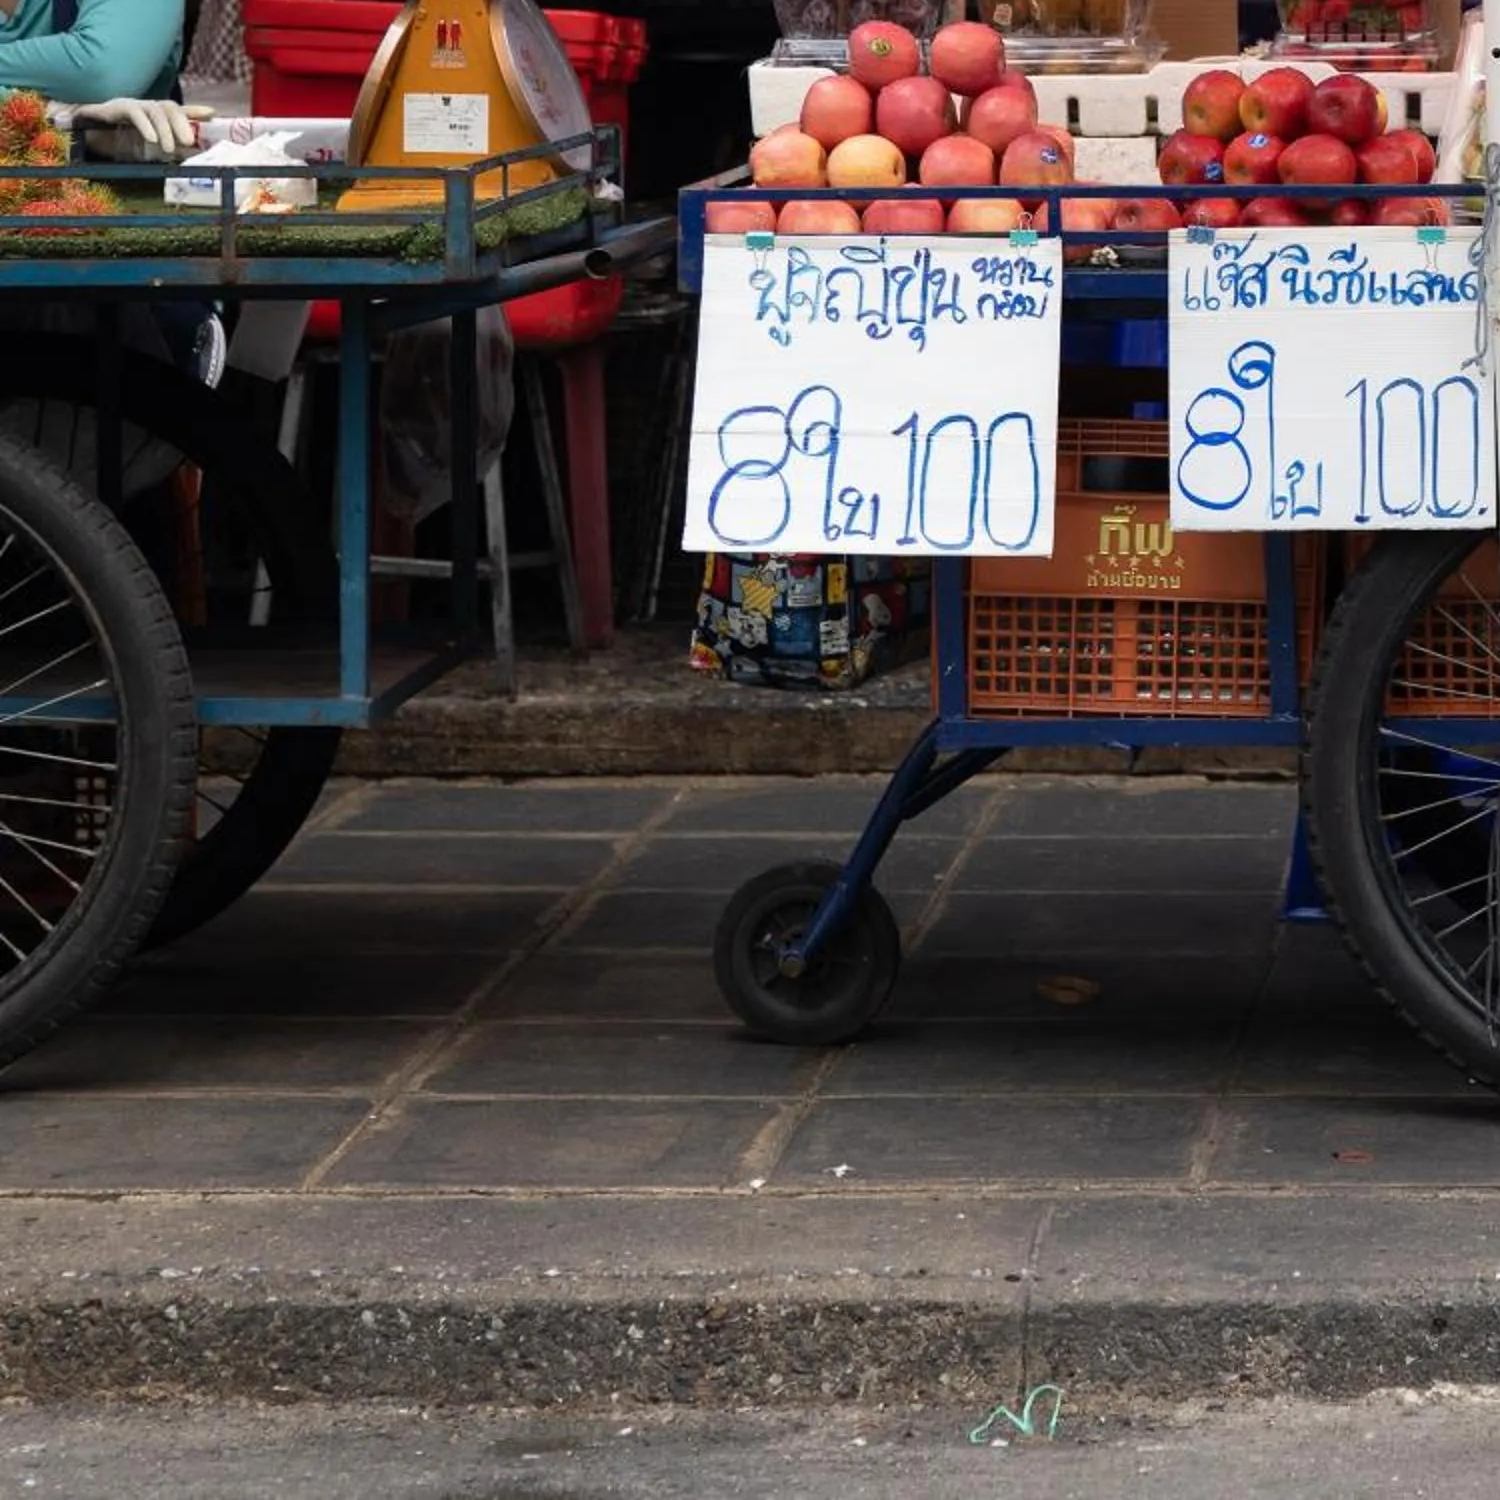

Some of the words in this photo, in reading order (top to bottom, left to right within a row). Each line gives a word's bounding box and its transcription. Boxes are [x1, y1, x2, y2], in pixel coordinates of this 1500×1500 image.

[971, 256, 1055, 289] หวาน
[976, 291, 1050, 321] กรอบ
[890, 411, 1041, 551] 100
